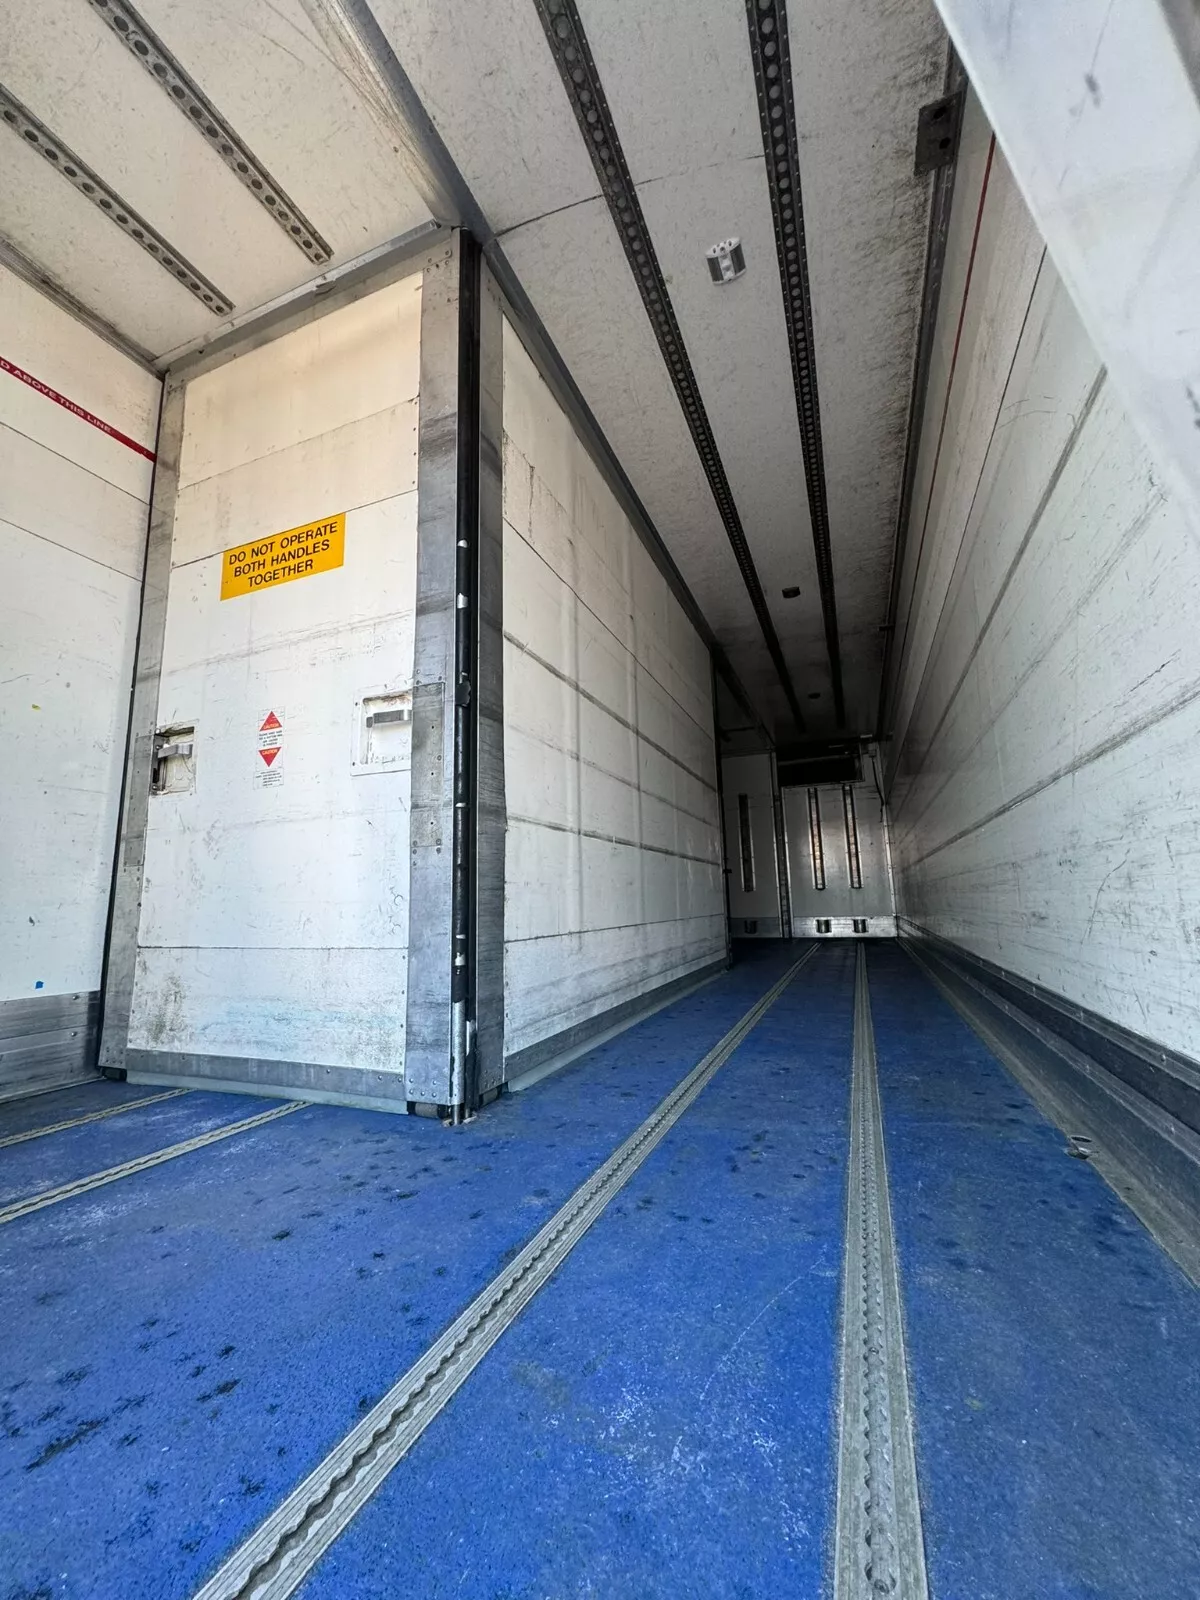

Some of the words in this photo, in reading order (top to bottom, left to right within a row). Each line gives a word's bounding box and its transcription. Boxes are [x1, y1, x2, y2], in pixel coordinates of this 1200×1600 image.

[14, 370, 57, 399] ABOVE
[59, 398, 85, 416] THIS
[87, 415, 112, 433] LINE
[229, 551, 246, 565] DO
[251, 542, 275, 558] NOT
[280, 522, 338, 549] OPERATE
[234, 559, 266, 578] BOTH
[270, 539, 330, 566] HANDLES
[248, 559, 313, 587] TOGETHER
